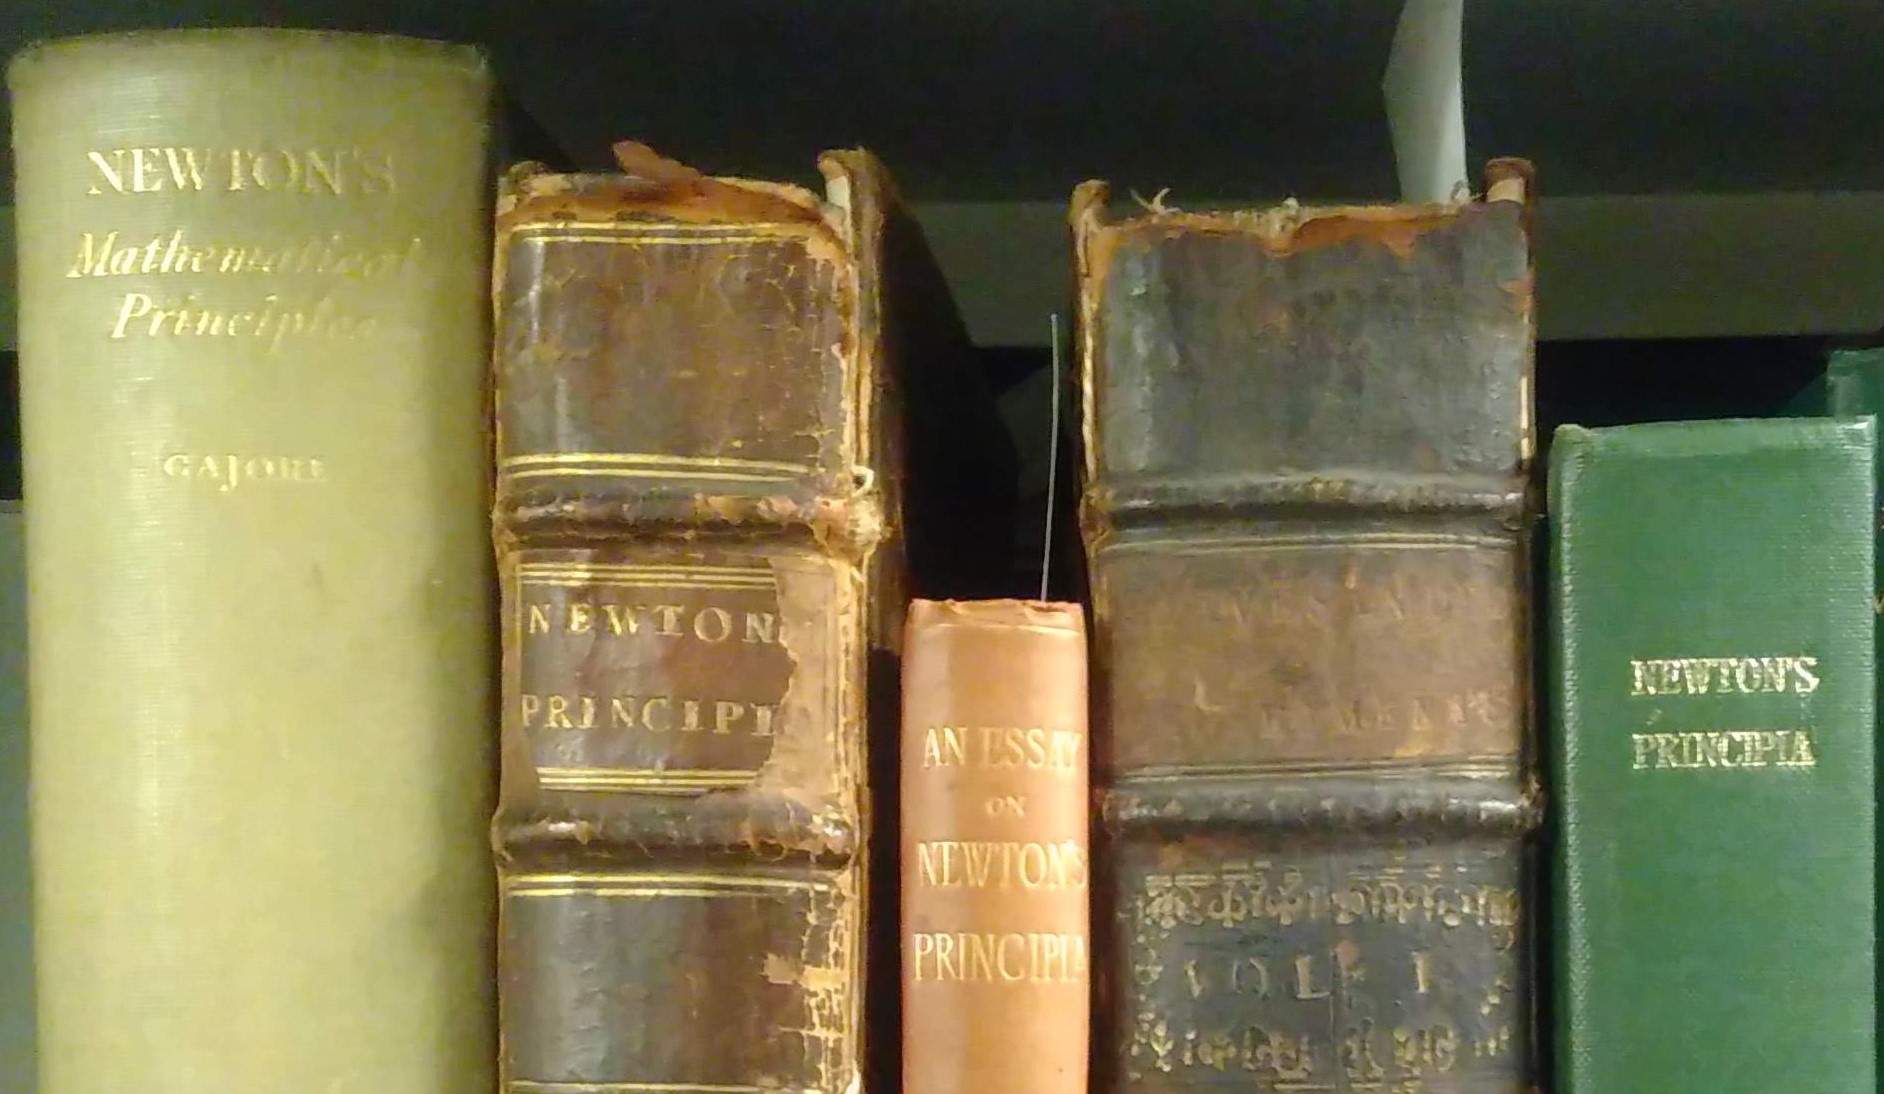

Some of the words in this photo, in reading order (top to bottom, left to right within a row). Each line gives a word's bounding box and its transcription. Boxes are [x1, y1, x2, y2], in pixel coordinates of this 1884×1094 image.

[87, 146, 398, 195] NEWTON'S
[528, 602, 778, 644] NEWTON
[1630, 656, 1821, 696] NEWTON'S
[923, 727, 968, 768] AN
[979, 727, 1082, 771] ESSAY
[1632, 730, 1816, 770] PRINCIPIA
[984, 795, 1027, 818] ON
